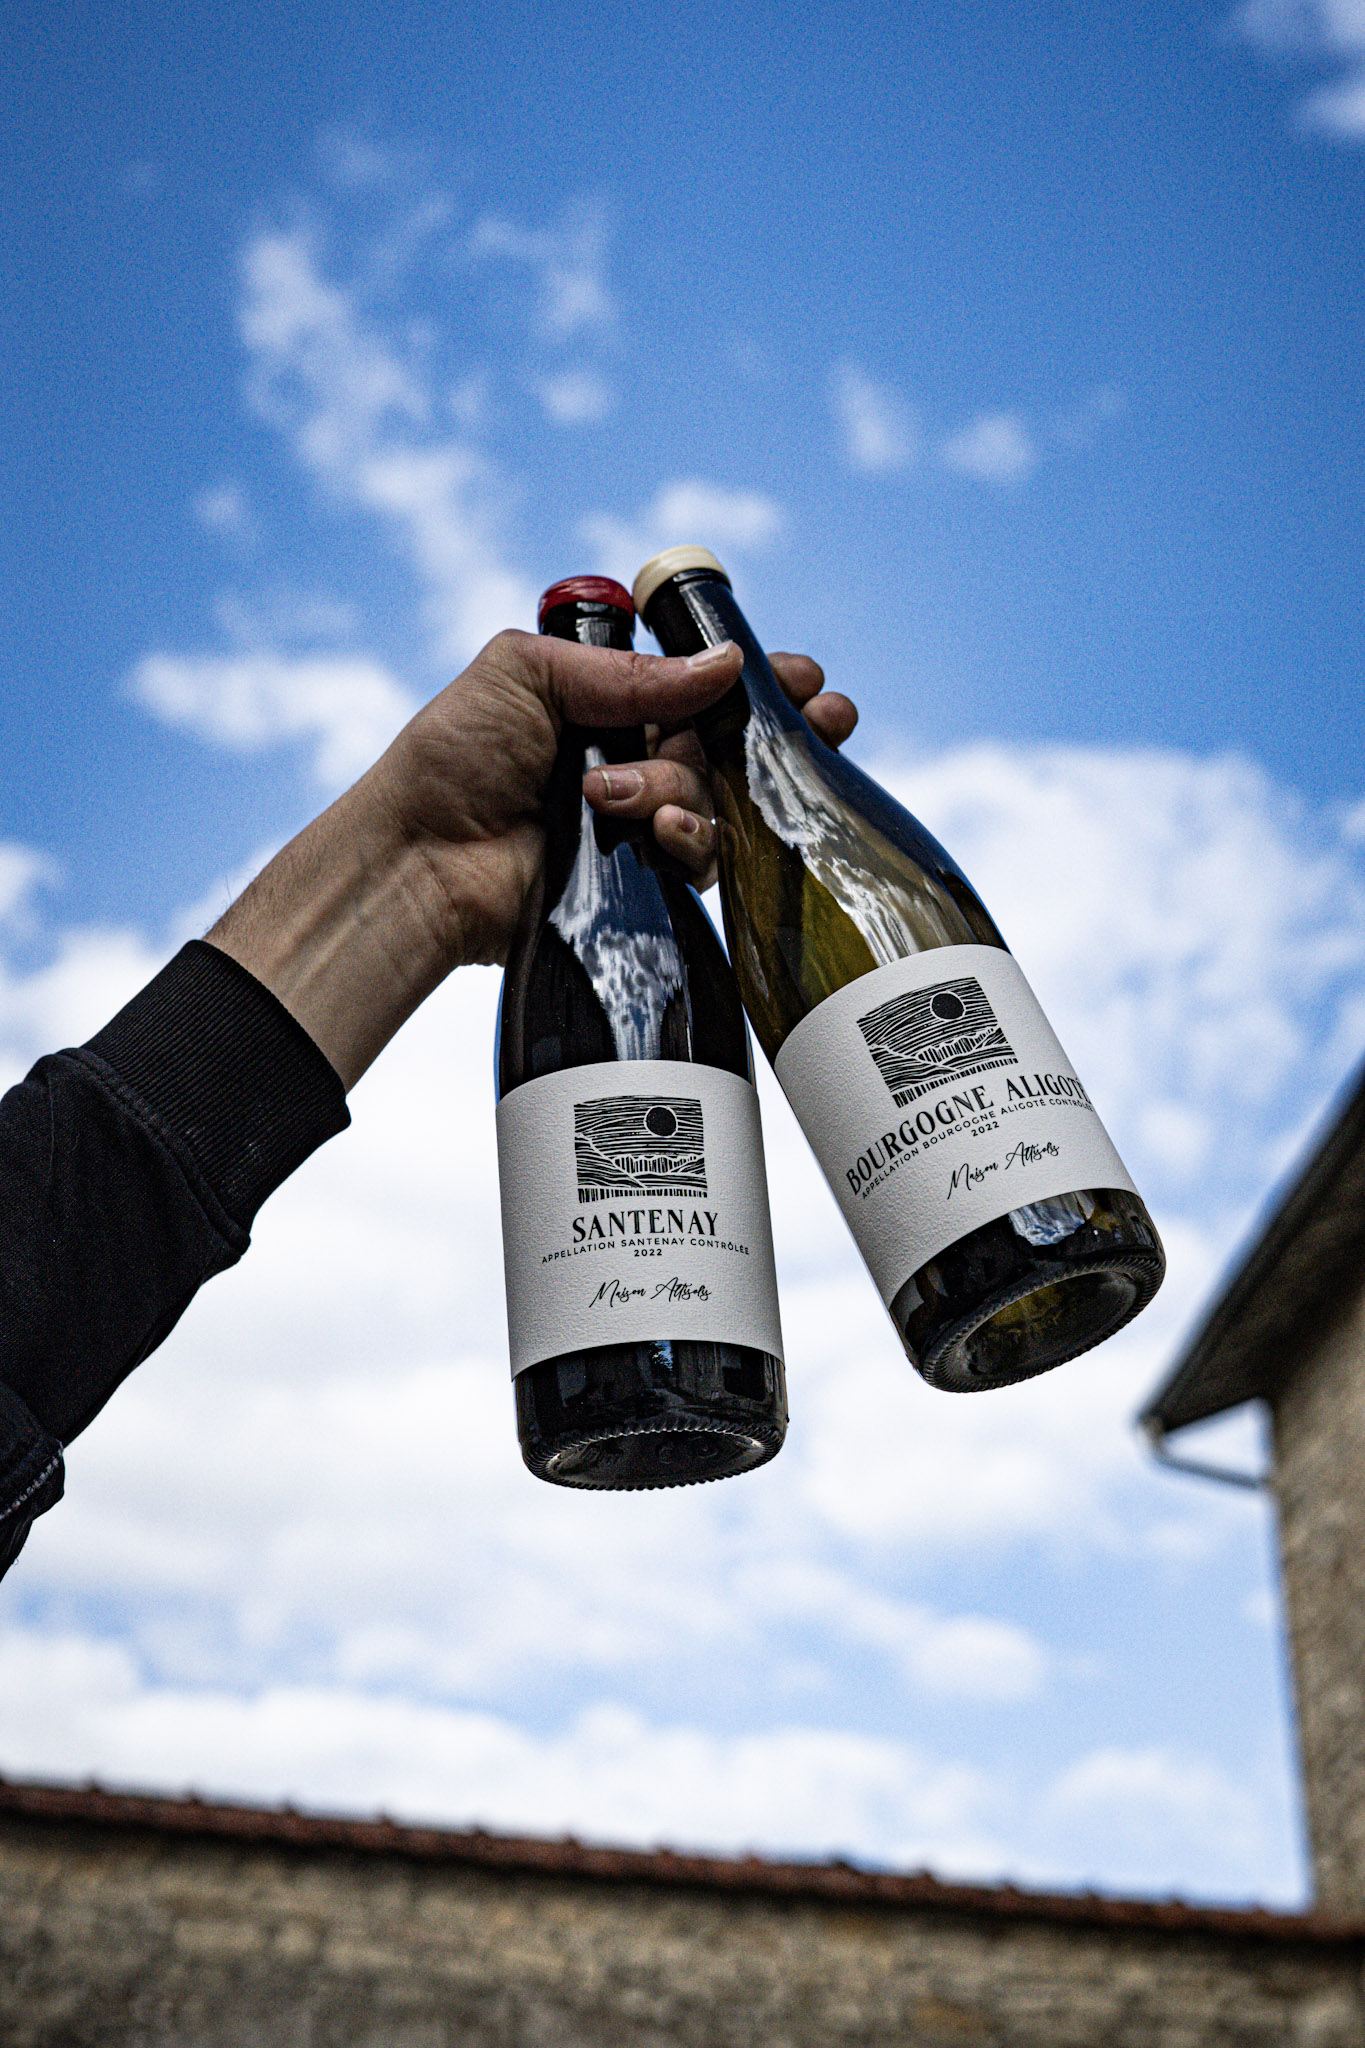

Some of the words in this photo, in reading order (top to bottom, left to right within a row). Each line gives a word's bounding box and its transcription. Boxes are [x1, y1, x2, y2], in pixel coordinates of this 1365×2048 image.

[845, 1084, 995, 1196] BOURGOGNE
[970, 1121, 1000, 1137] 2022
[861, 1148, 920, 1200] APPELLATION
[923, 1110, 996, 1150] BOURGOGNE
[1000, 1098, 1046, 1115] ALIGOTÉ
[946, 1161, 999, 1200] Maison
[572, 1209, 719, 1243] SANTENAY
[541, 1240, 616, 1264] APPELLATION
[620, 1237, 685, 1247] SANTENAY
[633, 1248, 663, 1257] 2022
[588, 1279, 646, 1308] Maison
